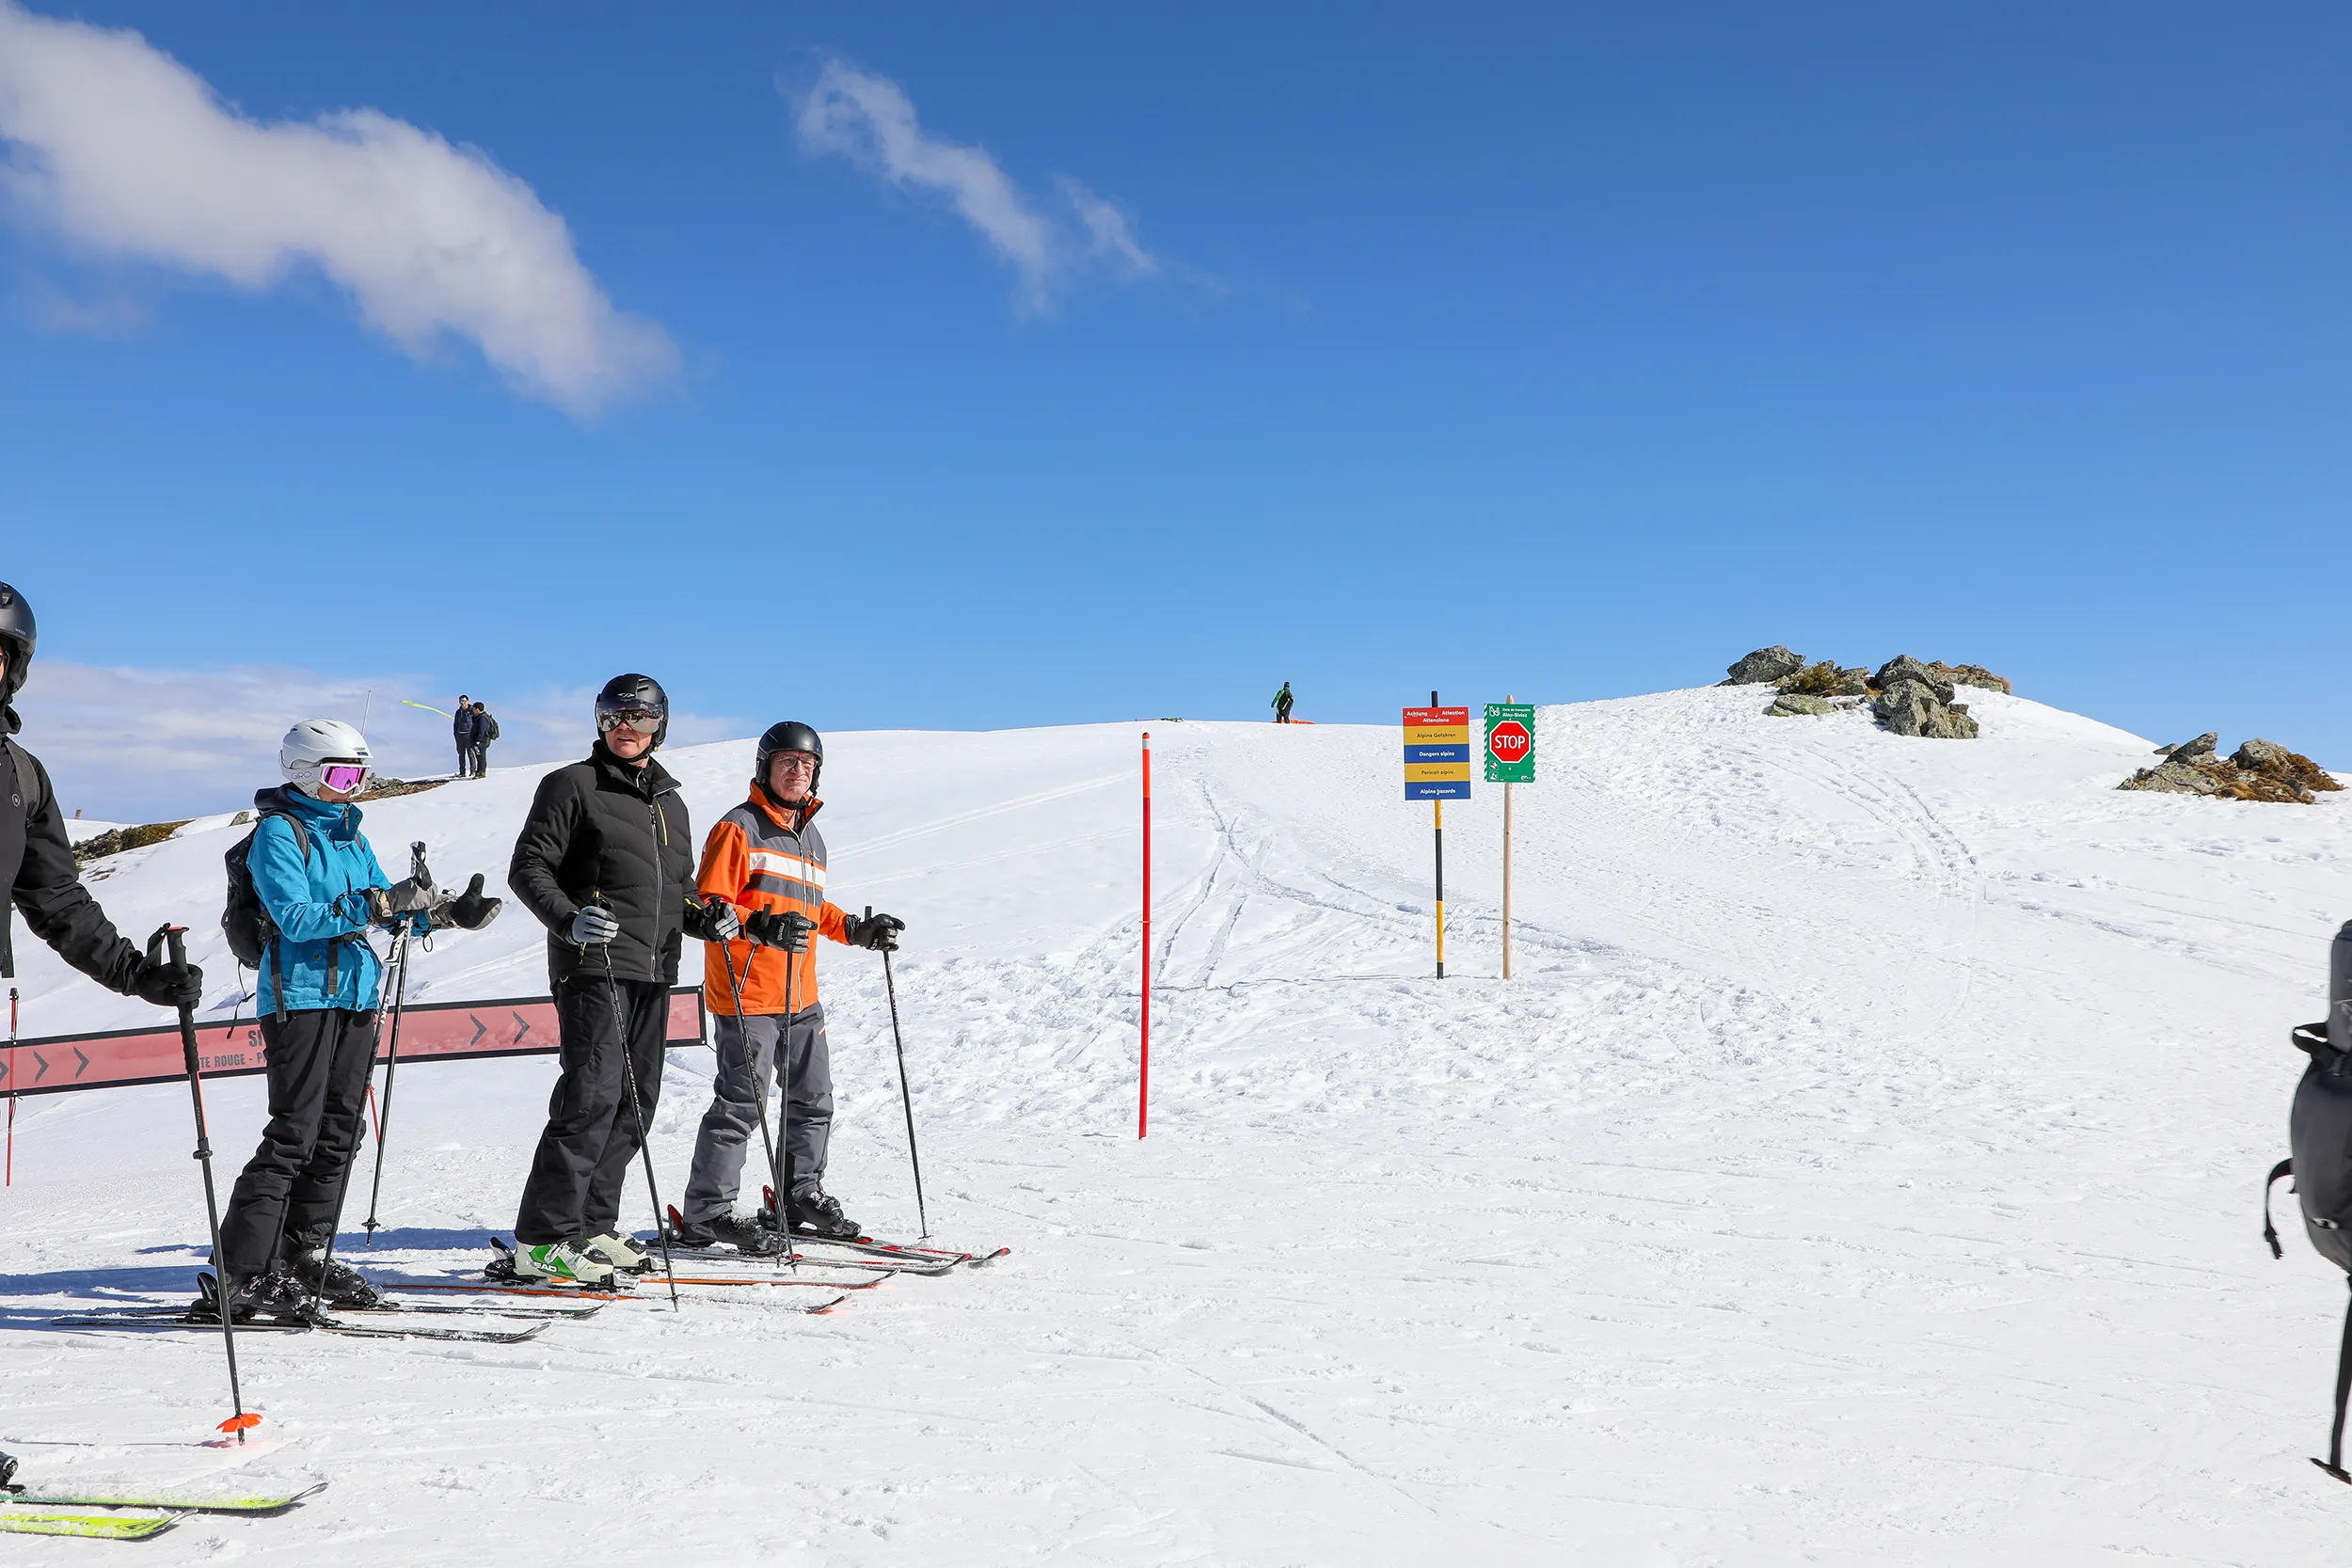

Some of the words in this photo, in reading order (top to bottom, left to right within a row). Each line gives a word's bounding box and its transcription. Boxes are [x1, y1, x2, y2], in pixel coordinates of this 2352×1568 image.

[1495, 735, 1526, 750] STOP
[290, 770, 312, 780] GIRO
[380, 994, 390, 1024] LEKI
[215, 1053, 246, 1067] ROUGE
[526, 1259, 558, 1273] HEAD
